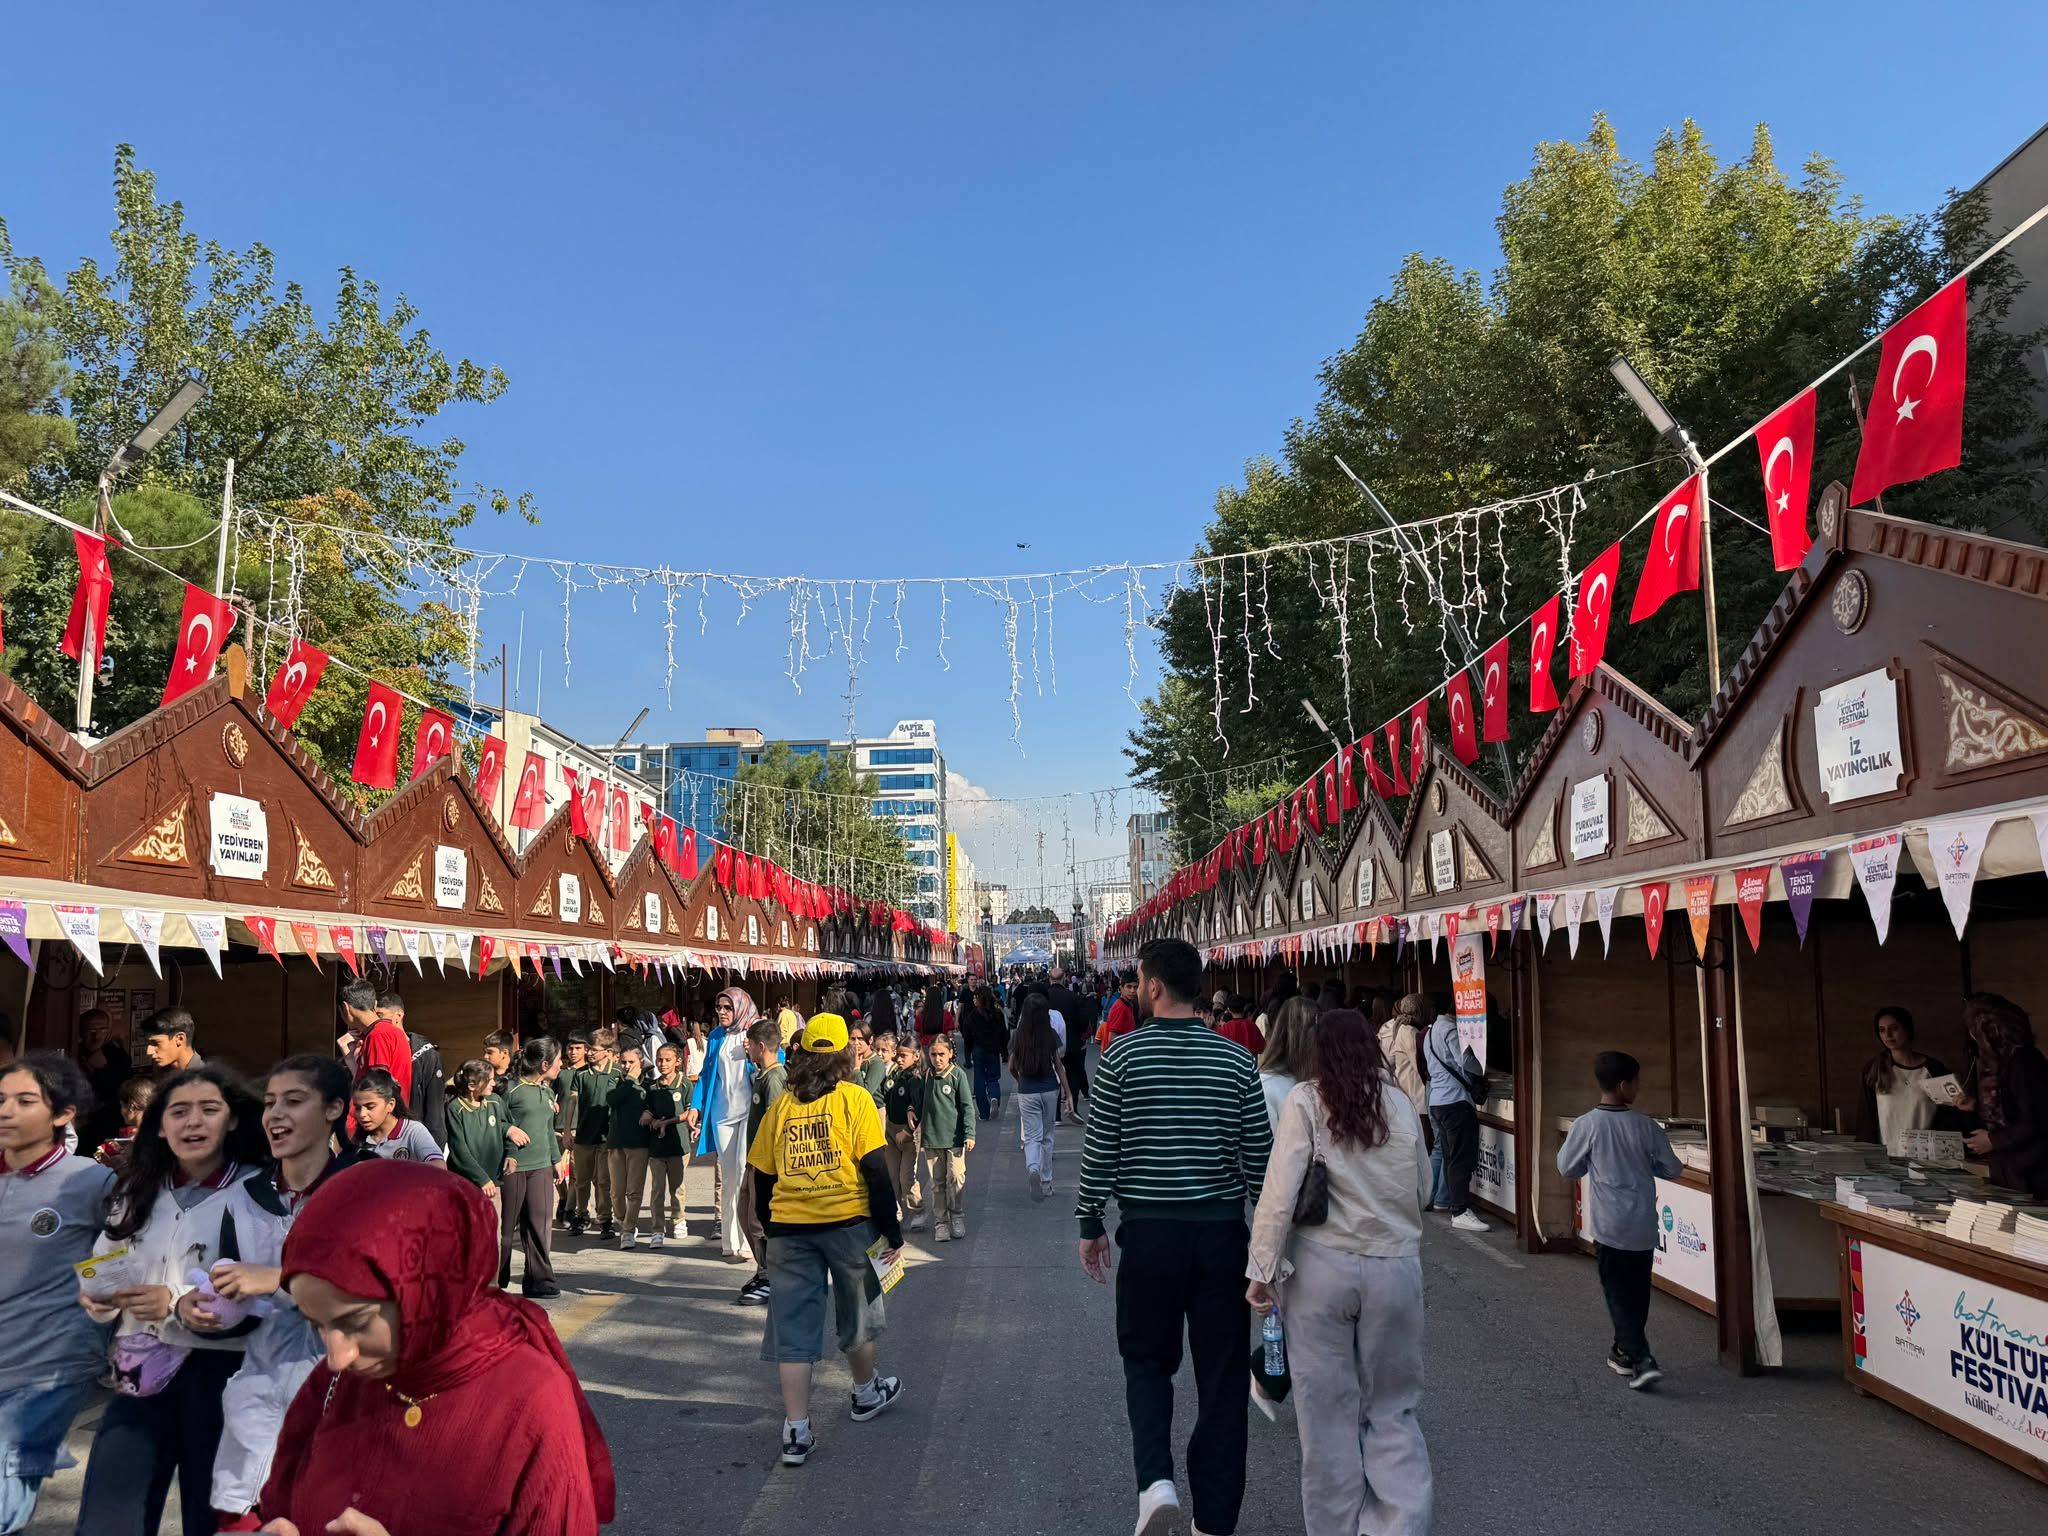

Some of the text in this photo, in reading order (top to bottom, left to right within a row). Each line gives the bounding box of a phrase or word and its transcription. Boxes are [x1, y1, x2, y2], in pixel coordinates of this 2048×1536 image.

[1849, 736, 1861, 756] İZ
[1827, 751, 1893, 782] YAYINCILIK
[218, 832, 264, 850] YEDİVEREN
[219, 848, 262, 864] YAYINLARI
[1789, 872, 1814, 887] TEKSTİL
[1791, 886, 1812, 896] FUARI
[1690, 896, 1708, 906] KİTAP
[1690, 906, 1709, 916] FUARI
[1478, 1149, 1498, 1169] ÜLTÜR
[1954, 1290, 2048, 1347] batman
[1950, 1349, 2048, 1419] FESTİVA
